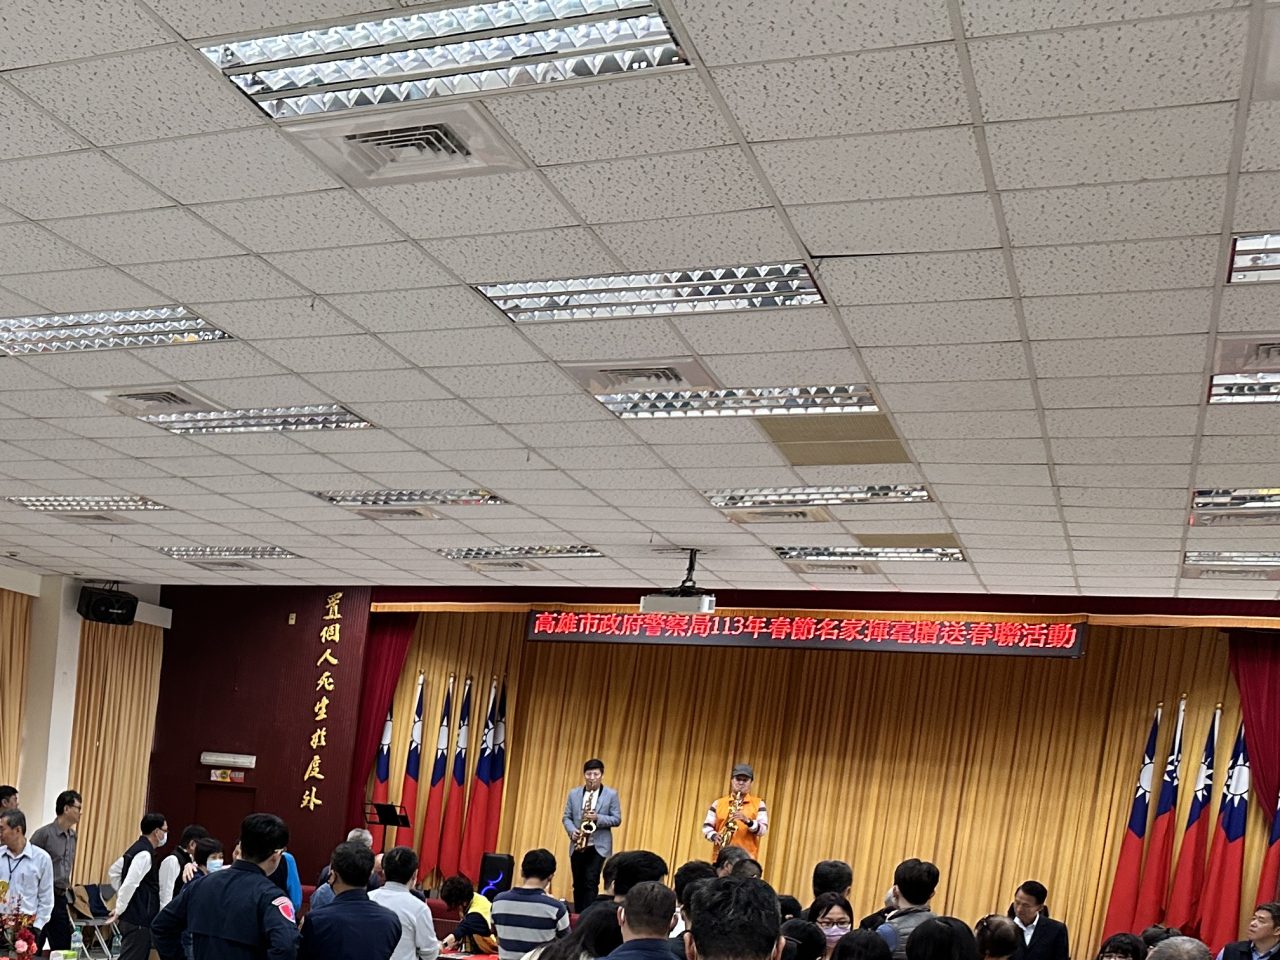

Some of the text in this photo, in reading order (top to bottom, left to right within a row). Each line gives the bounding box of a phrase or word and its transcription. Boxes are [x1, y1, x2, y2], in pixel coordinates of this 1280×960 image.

[534, 612, 1076, 648] 高雄市政府警察局113年春節名家揮毫贈送春聯活動
